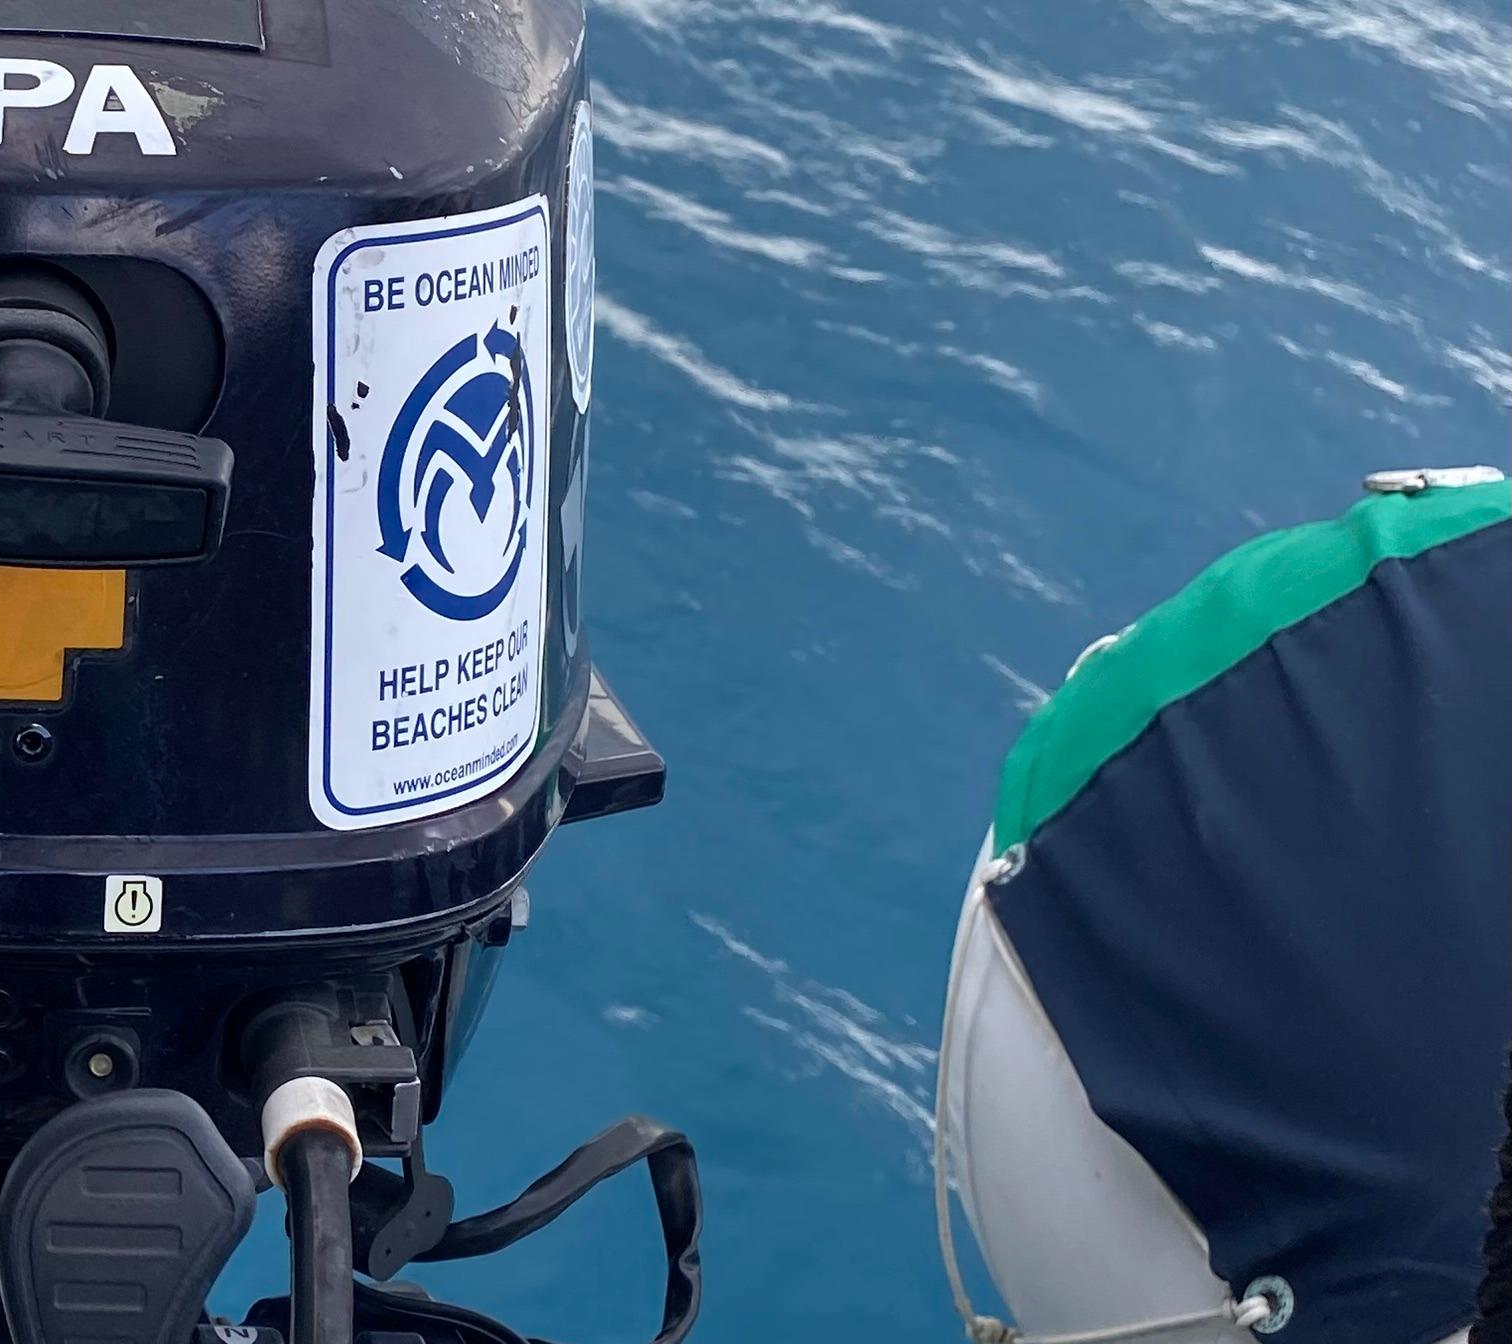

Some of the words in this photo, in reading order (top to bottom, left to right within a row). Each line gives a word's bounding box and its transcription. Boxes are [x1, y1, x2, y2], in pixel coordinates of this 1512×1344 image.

[363, 276, 405, 313] BE
[414, 261, 494, 307] OCEAN
[498, 245, 540, 292] MINDED
[378, 658, 450, 702] HELP
[456, 638, 505, 685] KEEP
[507, 619, 528, 662] OUR
[371, 693, 488, 752] BEACHES
[492, 662, 529, 718] CLEAN
[392, 733, 519, 796] www.oceanminded.com
